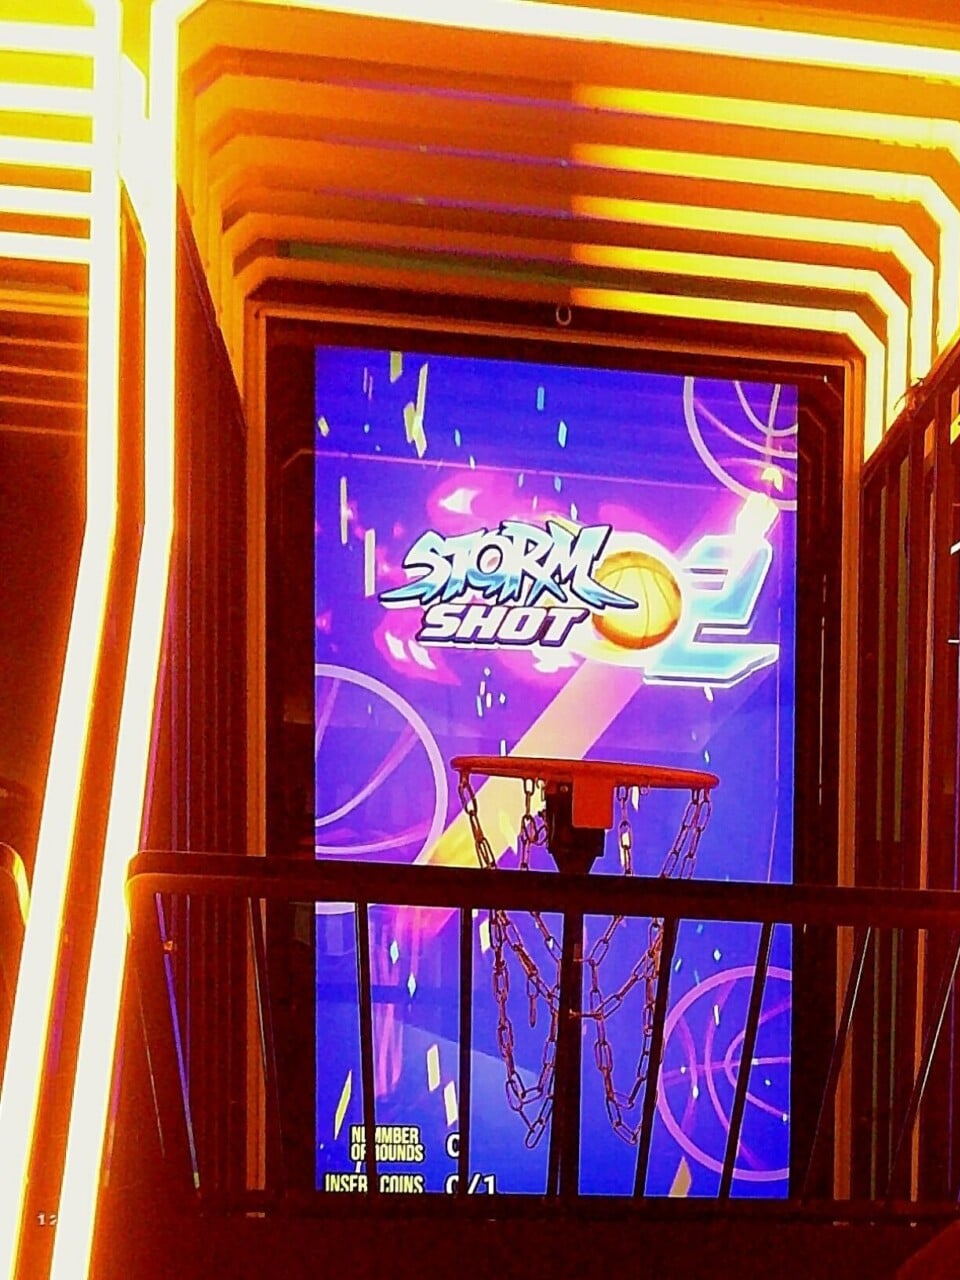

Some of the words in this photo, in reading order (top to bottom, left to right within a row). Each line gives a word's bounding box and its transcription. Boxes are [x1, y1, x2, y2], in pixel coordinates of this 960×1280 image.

[379, 520, 638, 608] STORM
[416, 602, 590, 648] SHOT
[643, 533, 780, 687] 2
